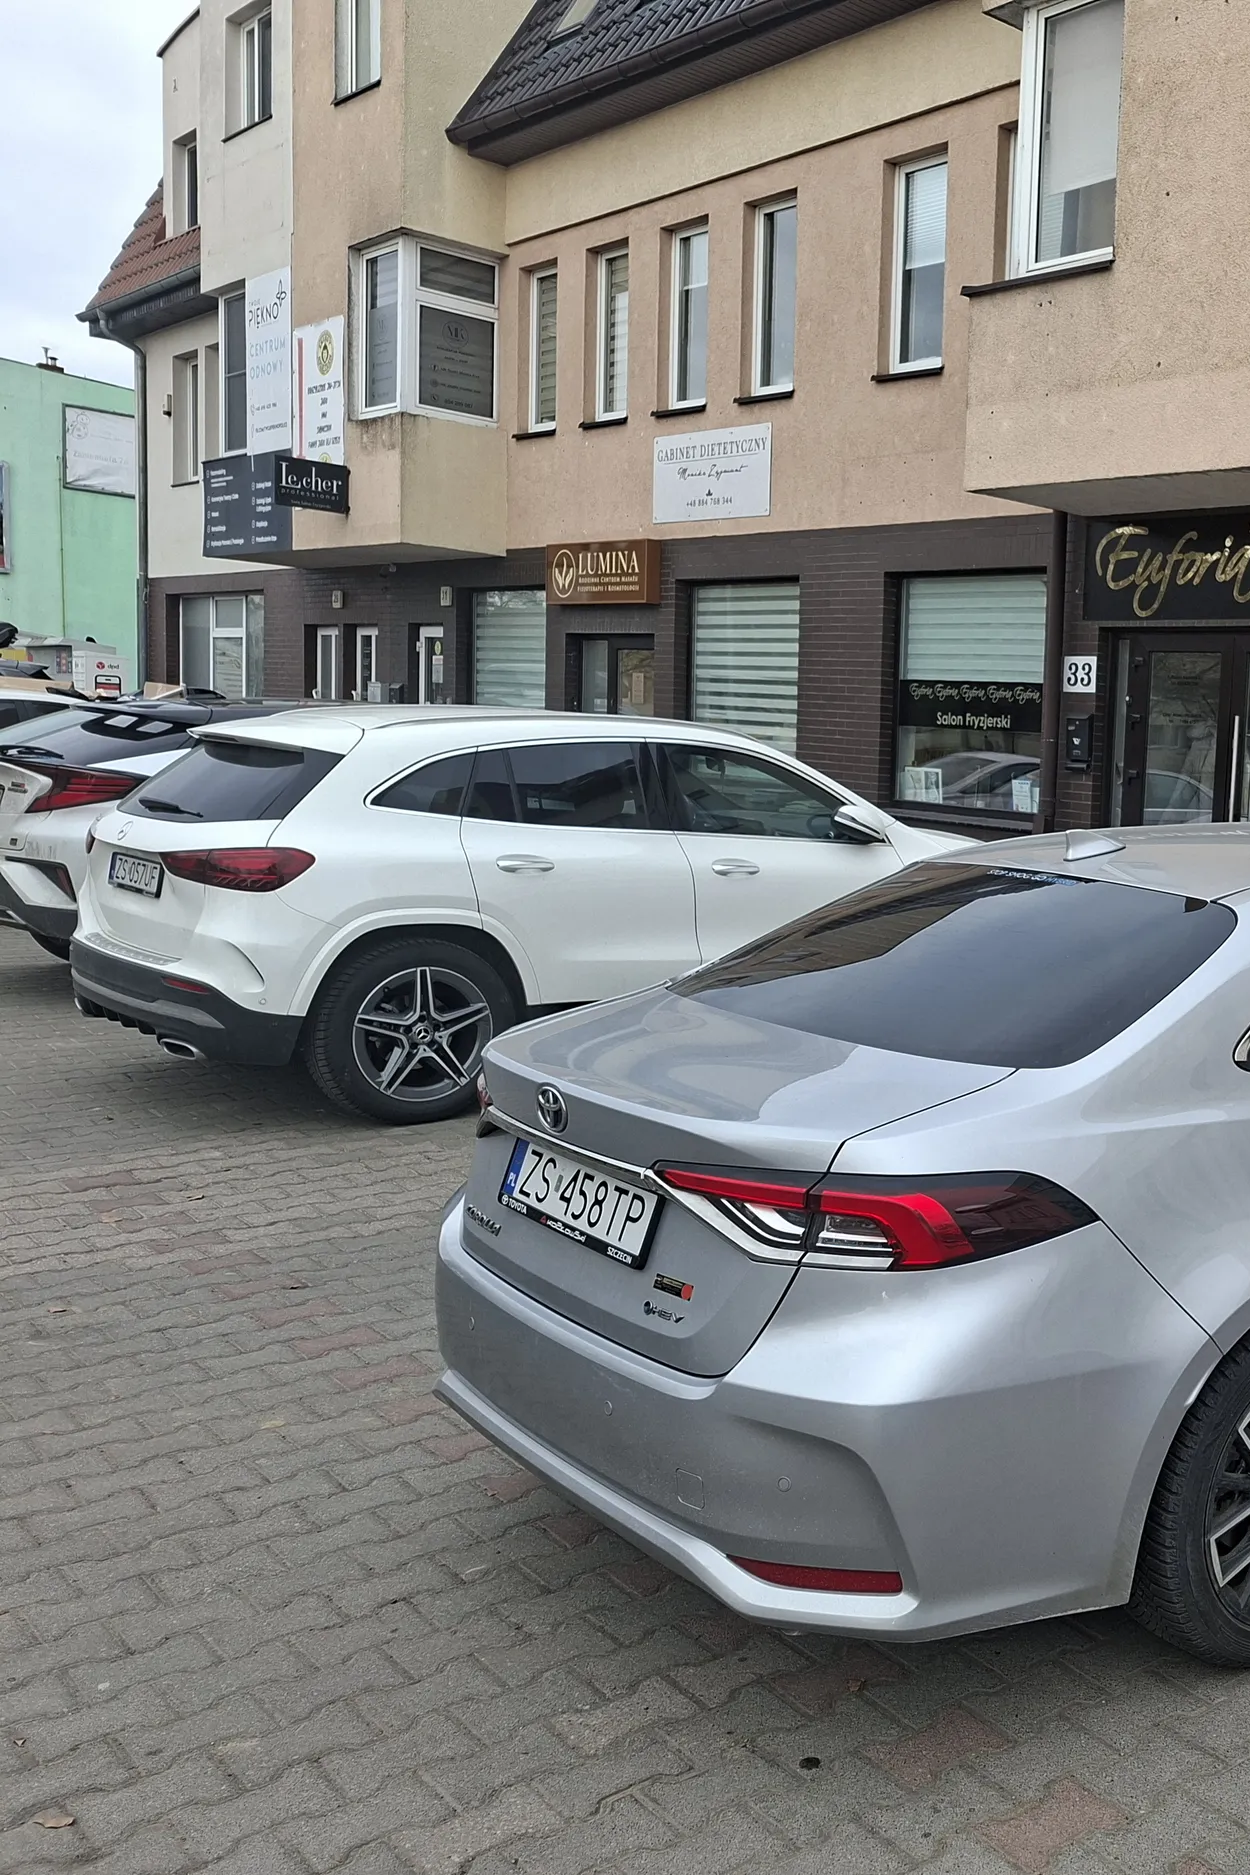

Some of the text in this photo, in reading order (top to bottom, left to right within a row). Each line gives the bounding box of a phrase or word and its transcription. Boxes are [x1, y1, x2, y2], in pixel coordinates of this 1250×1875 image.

[248, 302, 279, 329] PIĘKNO
[249, 337, 286, 358] CENTRUM
[249, 360, 283, 380] ODNOWY
[657, 437, 768, 463] GABINET DIETETYCZNY
[281, 488, 340, 500] professional
[686, 499, 696, 507] +48
[722, 496, 733, 505] 344
[578, 550, 640, 575] LUMINA
[1067, 662, 1092, 687] 33
[936, 712, 1011, 730] Salon Fryzjerski
[115, 857, 158, 888] ZS 057UF
[507, 1172, 516, 1187] PL
[518, 1149, 646, 1242] ZS 458TP
[508, 1199, 527, 1215] TOYOTA
[607, 1246, 632, 1265] SZCZECIN
